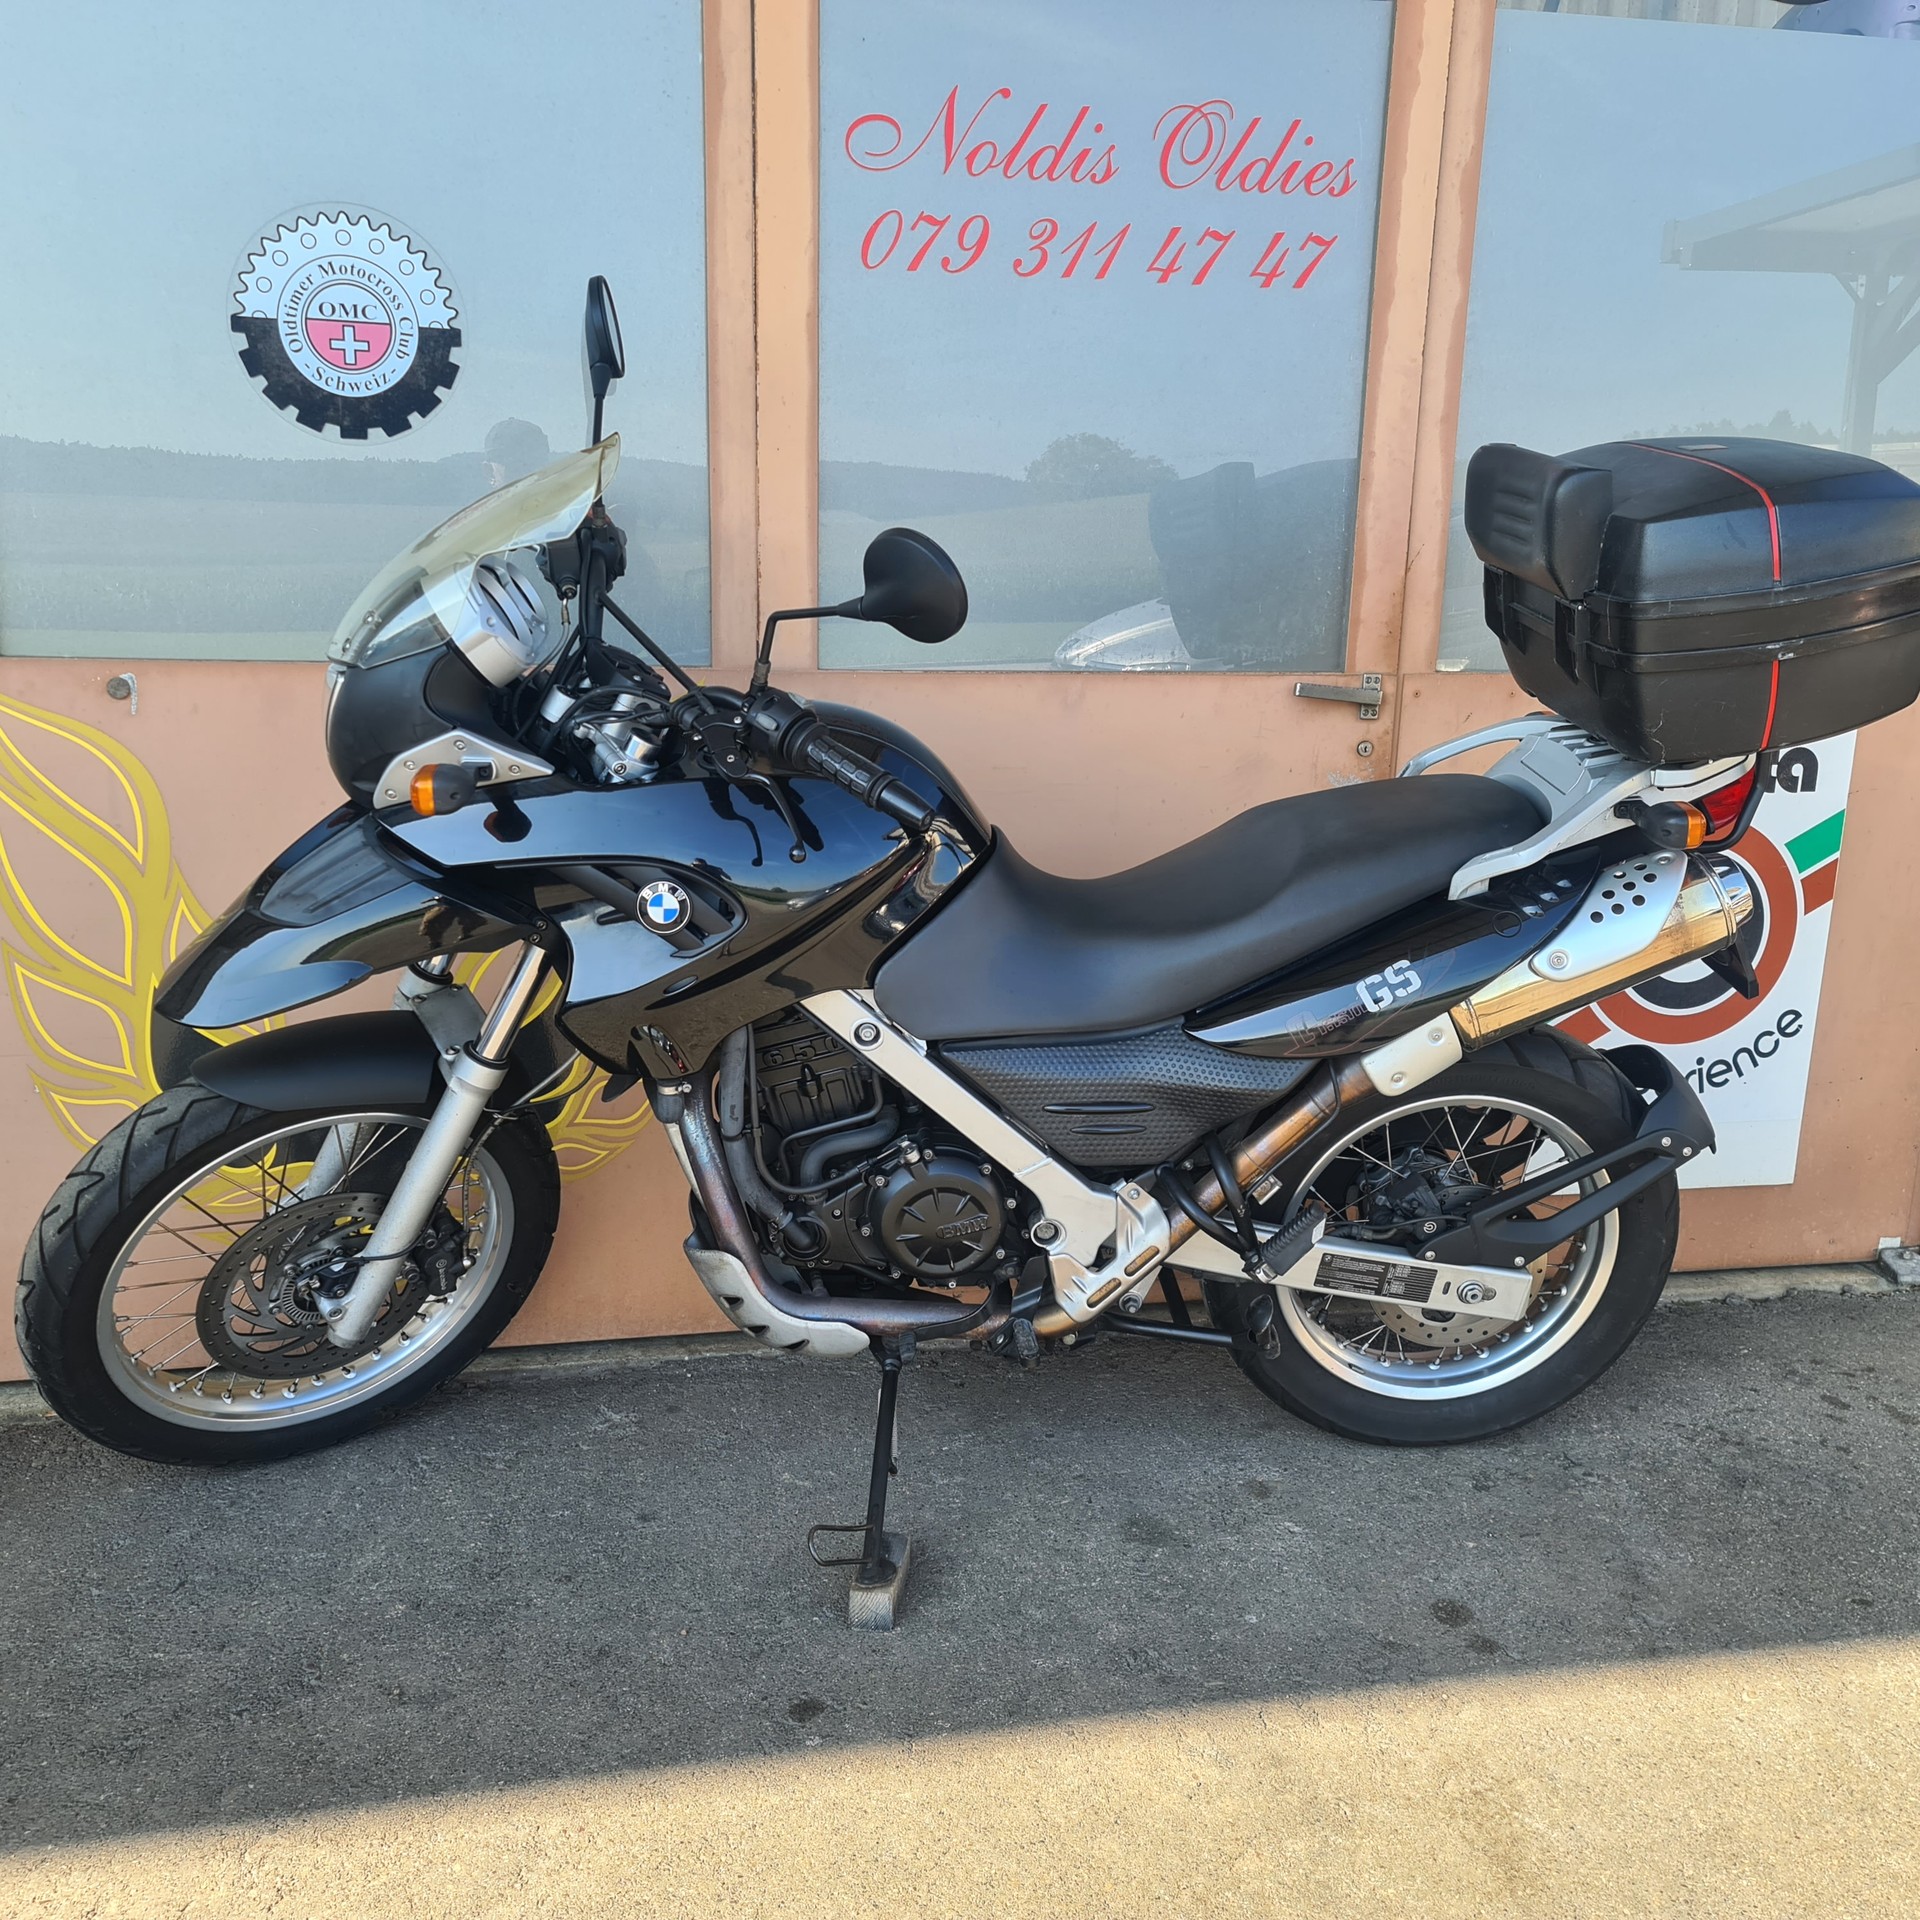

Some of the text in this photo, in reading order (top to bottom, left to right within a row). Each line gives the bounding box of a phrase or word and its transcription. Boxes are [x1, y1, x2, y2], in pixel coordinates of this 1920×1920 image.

[844, 85, 1357, 198] Noldis Oldies
[861, 209, 1338, 289] 079 311 47 47
[283, 261, 414, 360] Oldtimer Motocross Club
[318, 301, 378, 320] OMC
[642, 883, 686, 901] BMW
[1355, 959, 1422, 1012] GS
[1685, 1009, 1804, 1094] rience
